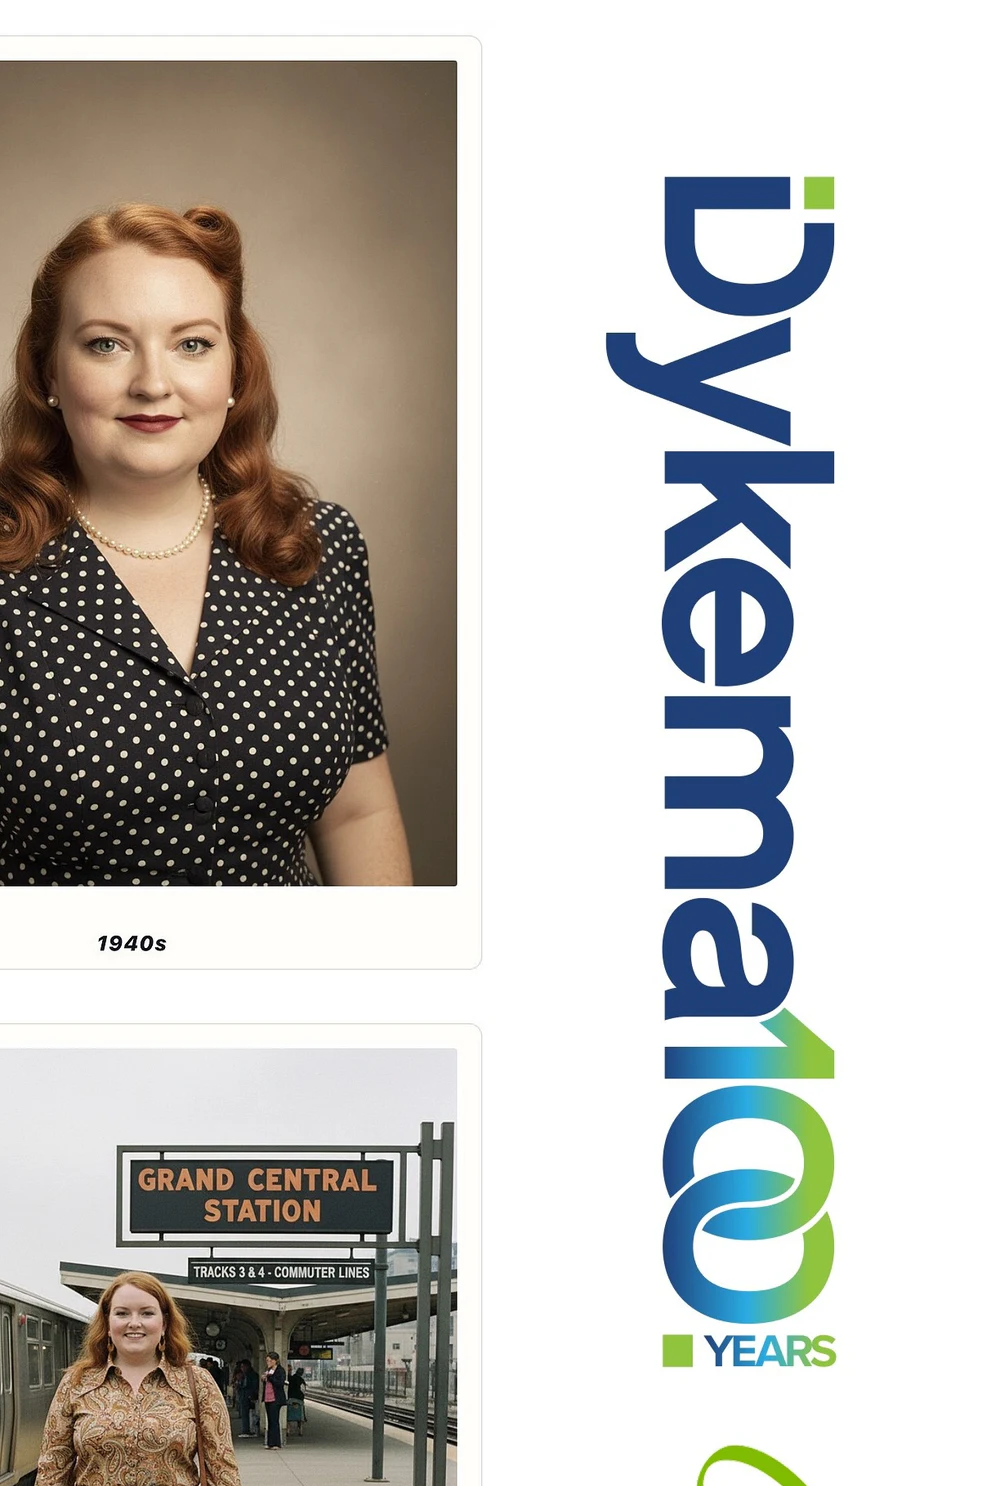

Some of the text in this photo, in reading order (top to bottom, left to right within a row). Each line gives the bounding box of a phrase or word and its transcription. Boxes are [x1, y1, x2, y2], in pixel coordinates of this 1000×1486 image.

[138, 1168, 378, 1192] GRAND CENTRAL
[204, 1198, 321, 1223] STATION
[193, 1266, 236, 1279] TRACKS
[238, 1266, 246, 1279] 3
[248, 1266, 256, 1279] &
[257, 1266, 265, 1279] 4
[274, 1266, 336, 1279] COMMUTER
[338, 1266, 370, 1279] LINES
